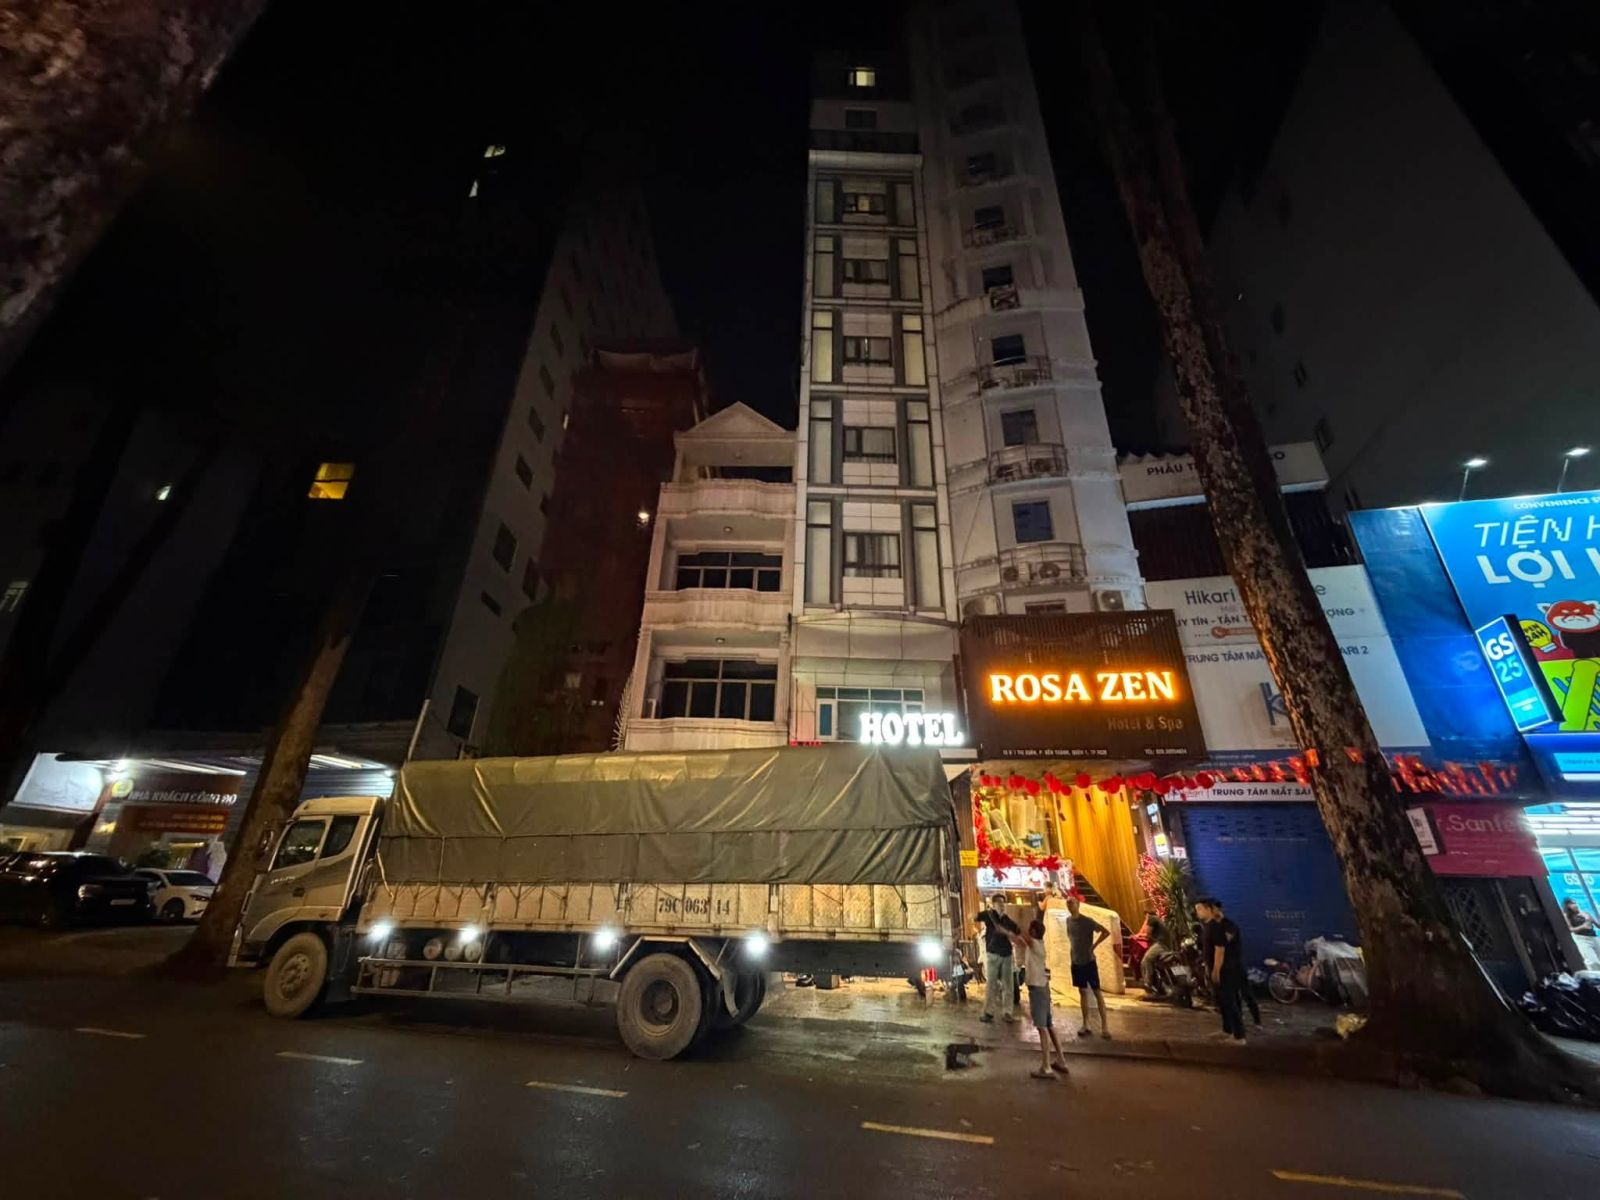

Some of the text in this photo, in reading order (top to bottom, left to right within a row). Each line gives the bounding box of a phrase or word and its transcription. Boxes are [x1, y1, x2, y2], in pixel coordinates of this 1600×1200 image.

[1513, 497, 1590, 509] CONVENIENCE
[1474, 514, 1572, 549] TIỆN
[1476, 549, 1576, 588] LỢI
[1184, 588, 1236, 605] Hikari
[1191, 616, 1209, 625] TÍN
[1326, 608, 1355, 618] ỢNG
[1361, 645, 1369, 655] 2
[1486, 633, 1514, 660] GS
[1496, 655, 1524, 683] 25
[989, 671, 1176, 701] ROSA ZEN
[859, 711, 965, 745] HOTEL
[1158, 716, 1184, 731] Spa
[1212, 788, 1244, 796] TRUNG
[1248, 786, 1268, 796] TÂM
[658, 897, 730, 915] 79C 063 14
